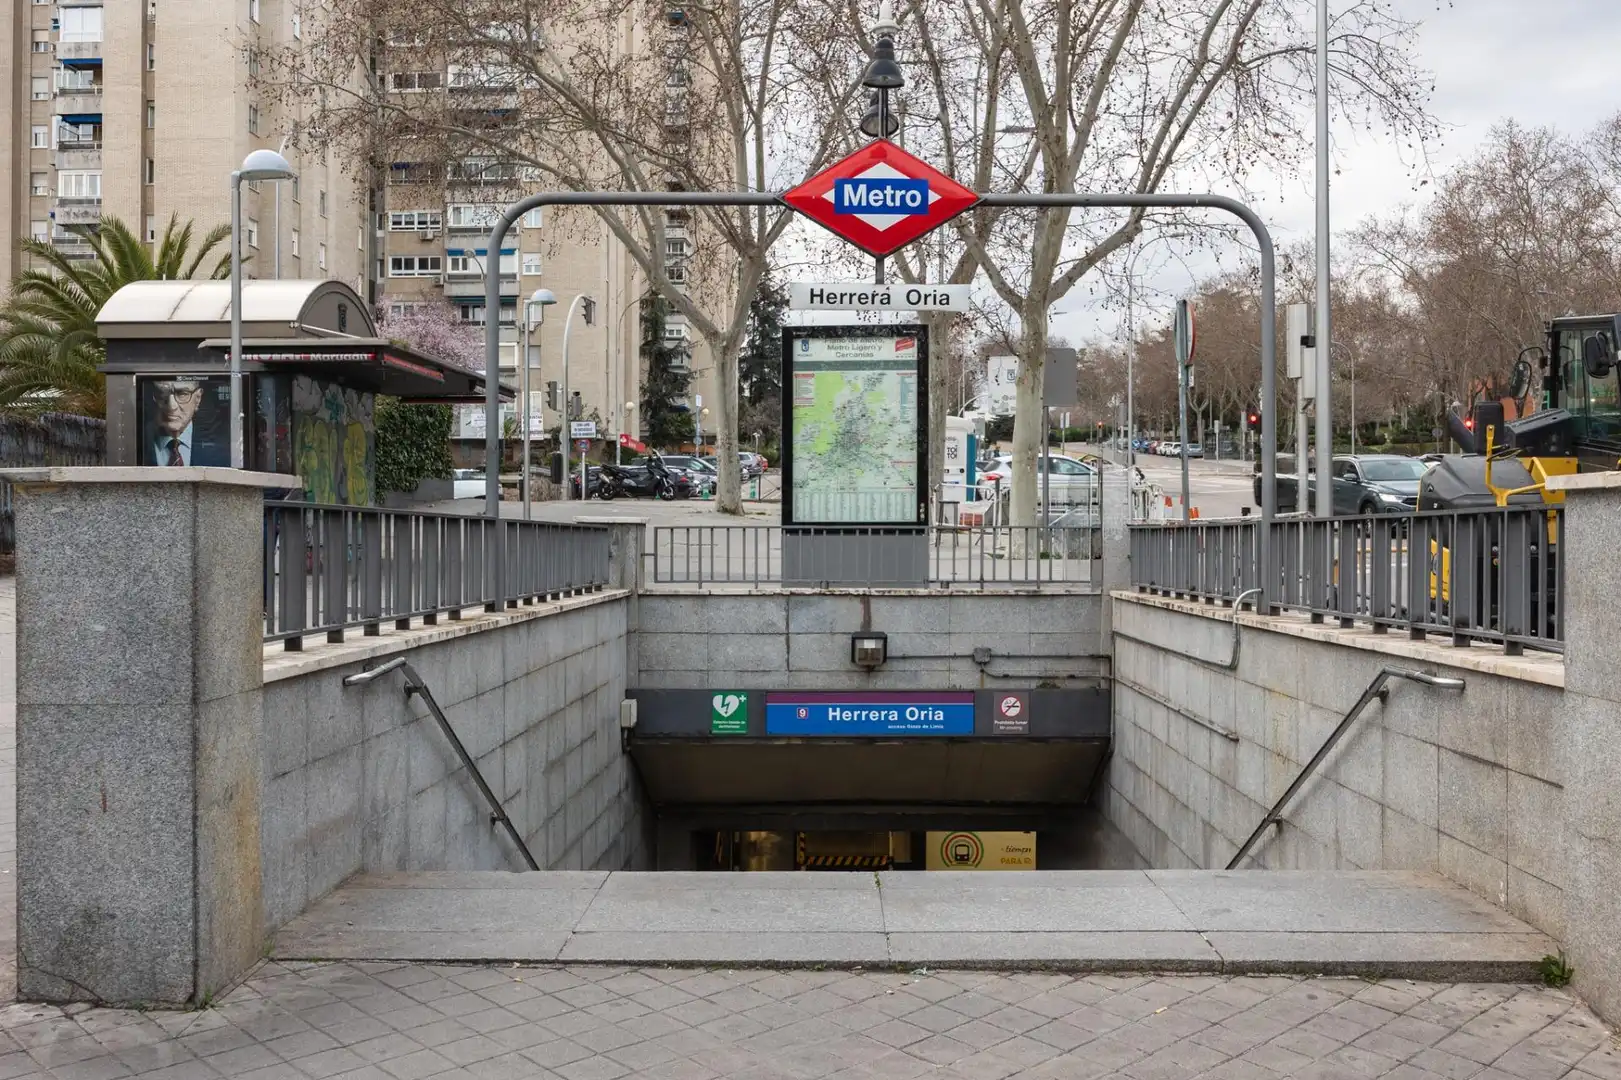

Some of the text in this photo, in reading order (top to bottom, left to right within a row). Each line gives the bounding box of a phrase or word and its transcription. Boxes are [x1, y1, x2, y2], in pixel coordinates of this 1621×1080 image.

[843, 184, 922, 207] Metro
[809, 288, 951, 306] Herrera Oria
[799, 707, 945, 721] 9 Herrera Oria
